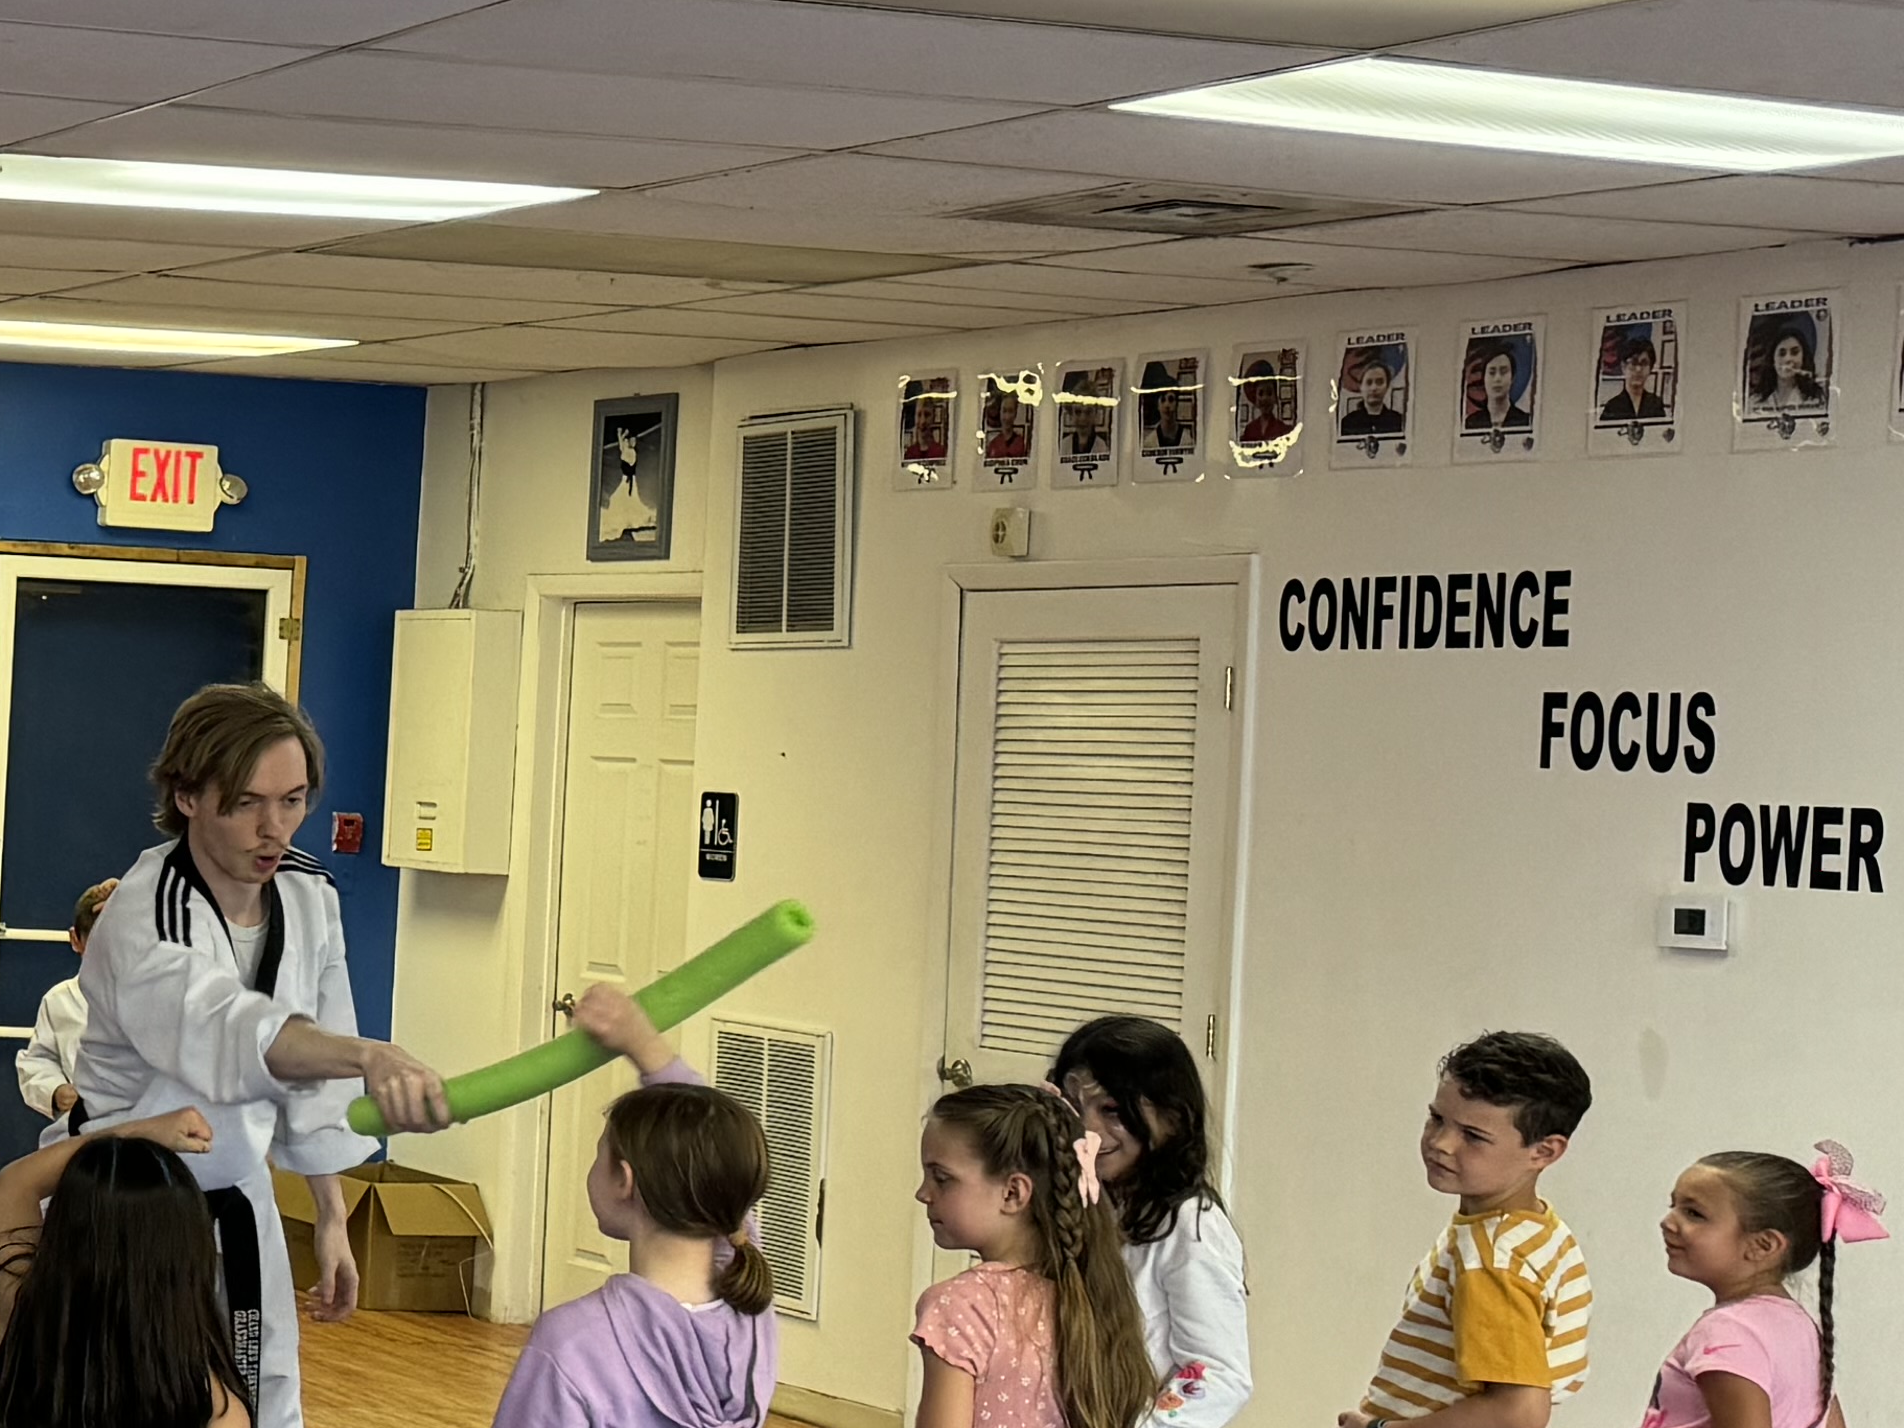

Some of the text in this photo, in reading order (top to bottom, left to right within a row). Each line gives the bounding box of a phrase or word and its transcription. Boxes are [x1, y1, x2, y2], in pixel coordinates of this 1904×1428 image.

[1606, 307, 1673, 323] LEADER
[1753, 296, 1828, 314] LEADER
[1347, 332, 1406, 346] LEADER
[1470, 321, 1533, 335] LEADER
[129, 447, 204, 504] EXIT
[1279, 570, 1572, 651] CONFIDENCE
[1540, 691, 1716, 774] FOCUS
[1684, 802, 1884, 893] POWER
